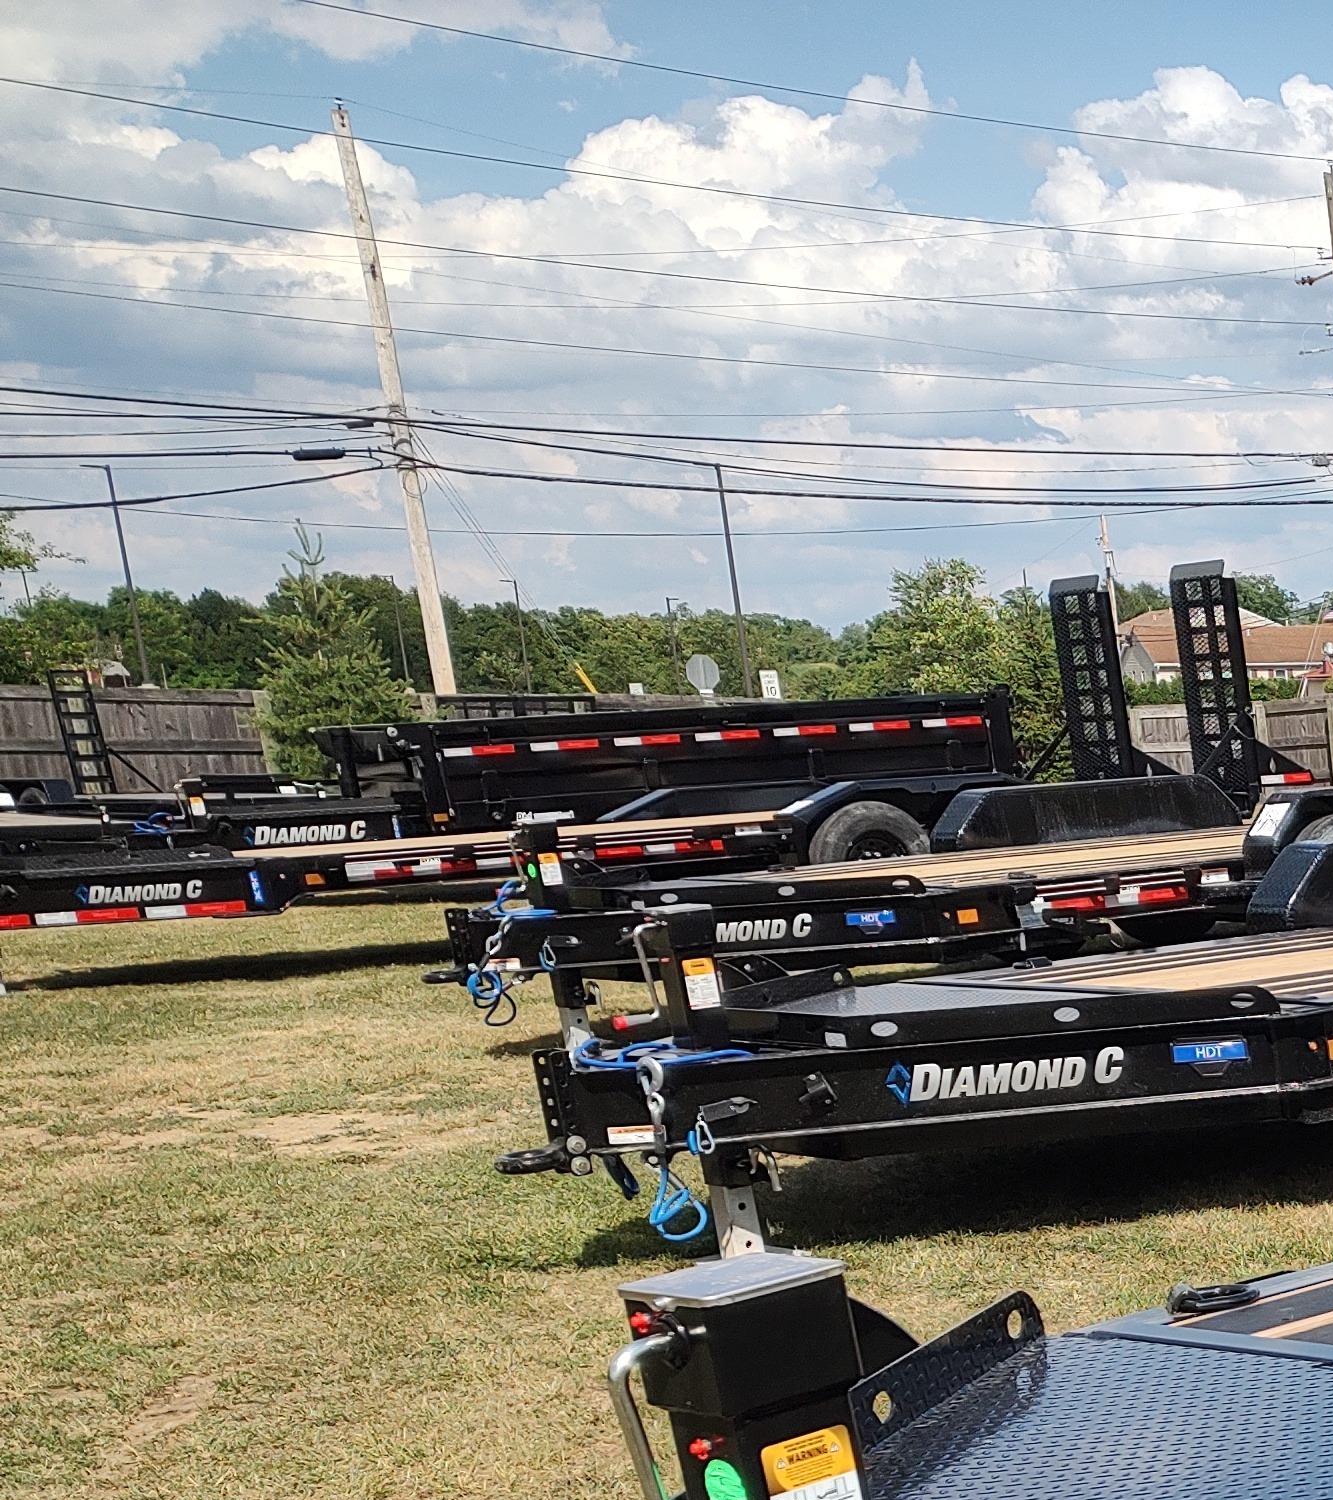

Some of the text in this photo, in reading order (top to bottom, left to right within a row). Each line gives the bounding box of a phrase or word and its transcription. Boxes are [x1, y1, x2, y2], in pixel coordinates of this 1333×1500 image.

[765, 686, 777, 697] 10
[254, 820, 366, 846] DIAMOND C
[88, 879, 202, 905] DIAMOND C
[715, 912, 812, 943] MOND C
[1195, 1045, 1224, 1060] HDT
[909, 1046, 1124, 1102] DIAMOND C
[785, 1444, 830, 1466] WARNING
